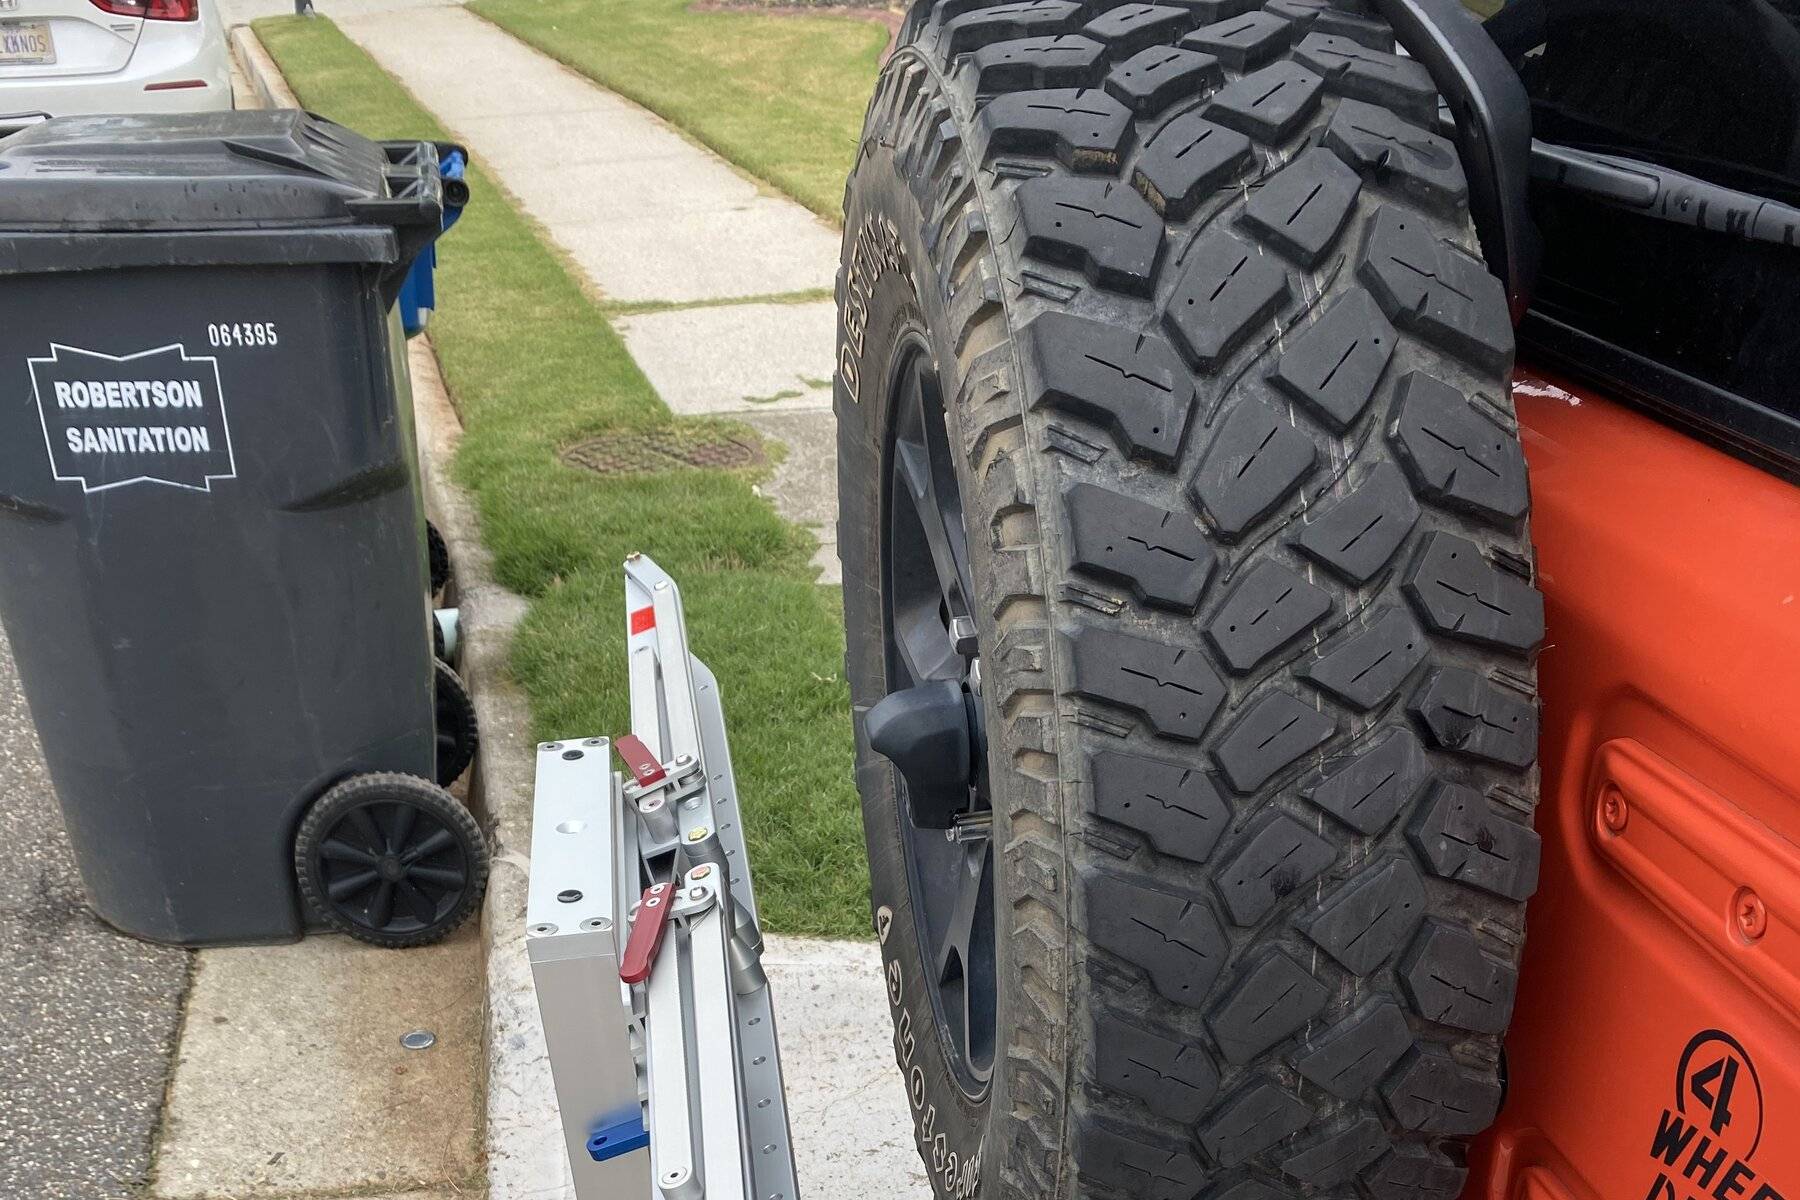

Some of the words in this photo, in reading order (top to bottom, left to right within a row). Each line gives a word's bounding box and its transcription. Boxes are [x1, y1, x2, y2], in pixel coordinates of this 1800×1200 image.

[208, 323, 278, 346] 064395
[54, 381, 203, 408] ROBERTSON
[66, 427, 210, 453] SANITATION
[1691, 1055, 1740, 1137] 4
